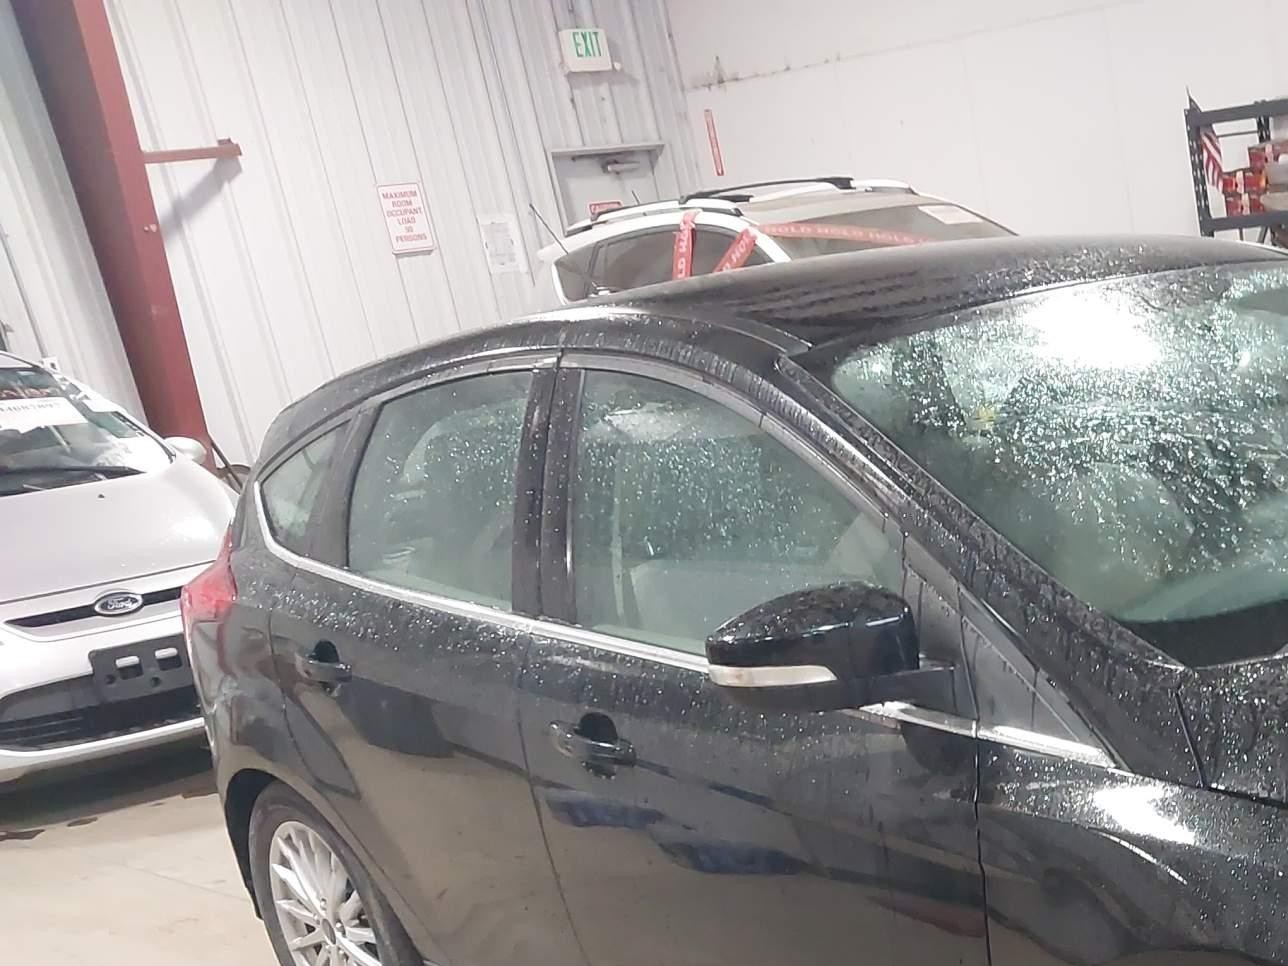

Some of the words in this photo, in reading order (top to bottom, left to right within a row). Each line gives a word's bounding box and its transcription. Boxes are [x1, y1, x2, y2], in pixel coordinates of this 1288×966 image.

[573, 32, 601, 57] EXIT
[382, 190, 418, 200] MAXIMUM
[392, 200, 413, 208] ROOM
[386, 207, 422, 217] OCCUPANT
[397, 216, 416, 226] LOAD
[395, 233, 427, 243] PERSONS
[106, 597, 139, 611] Ford
